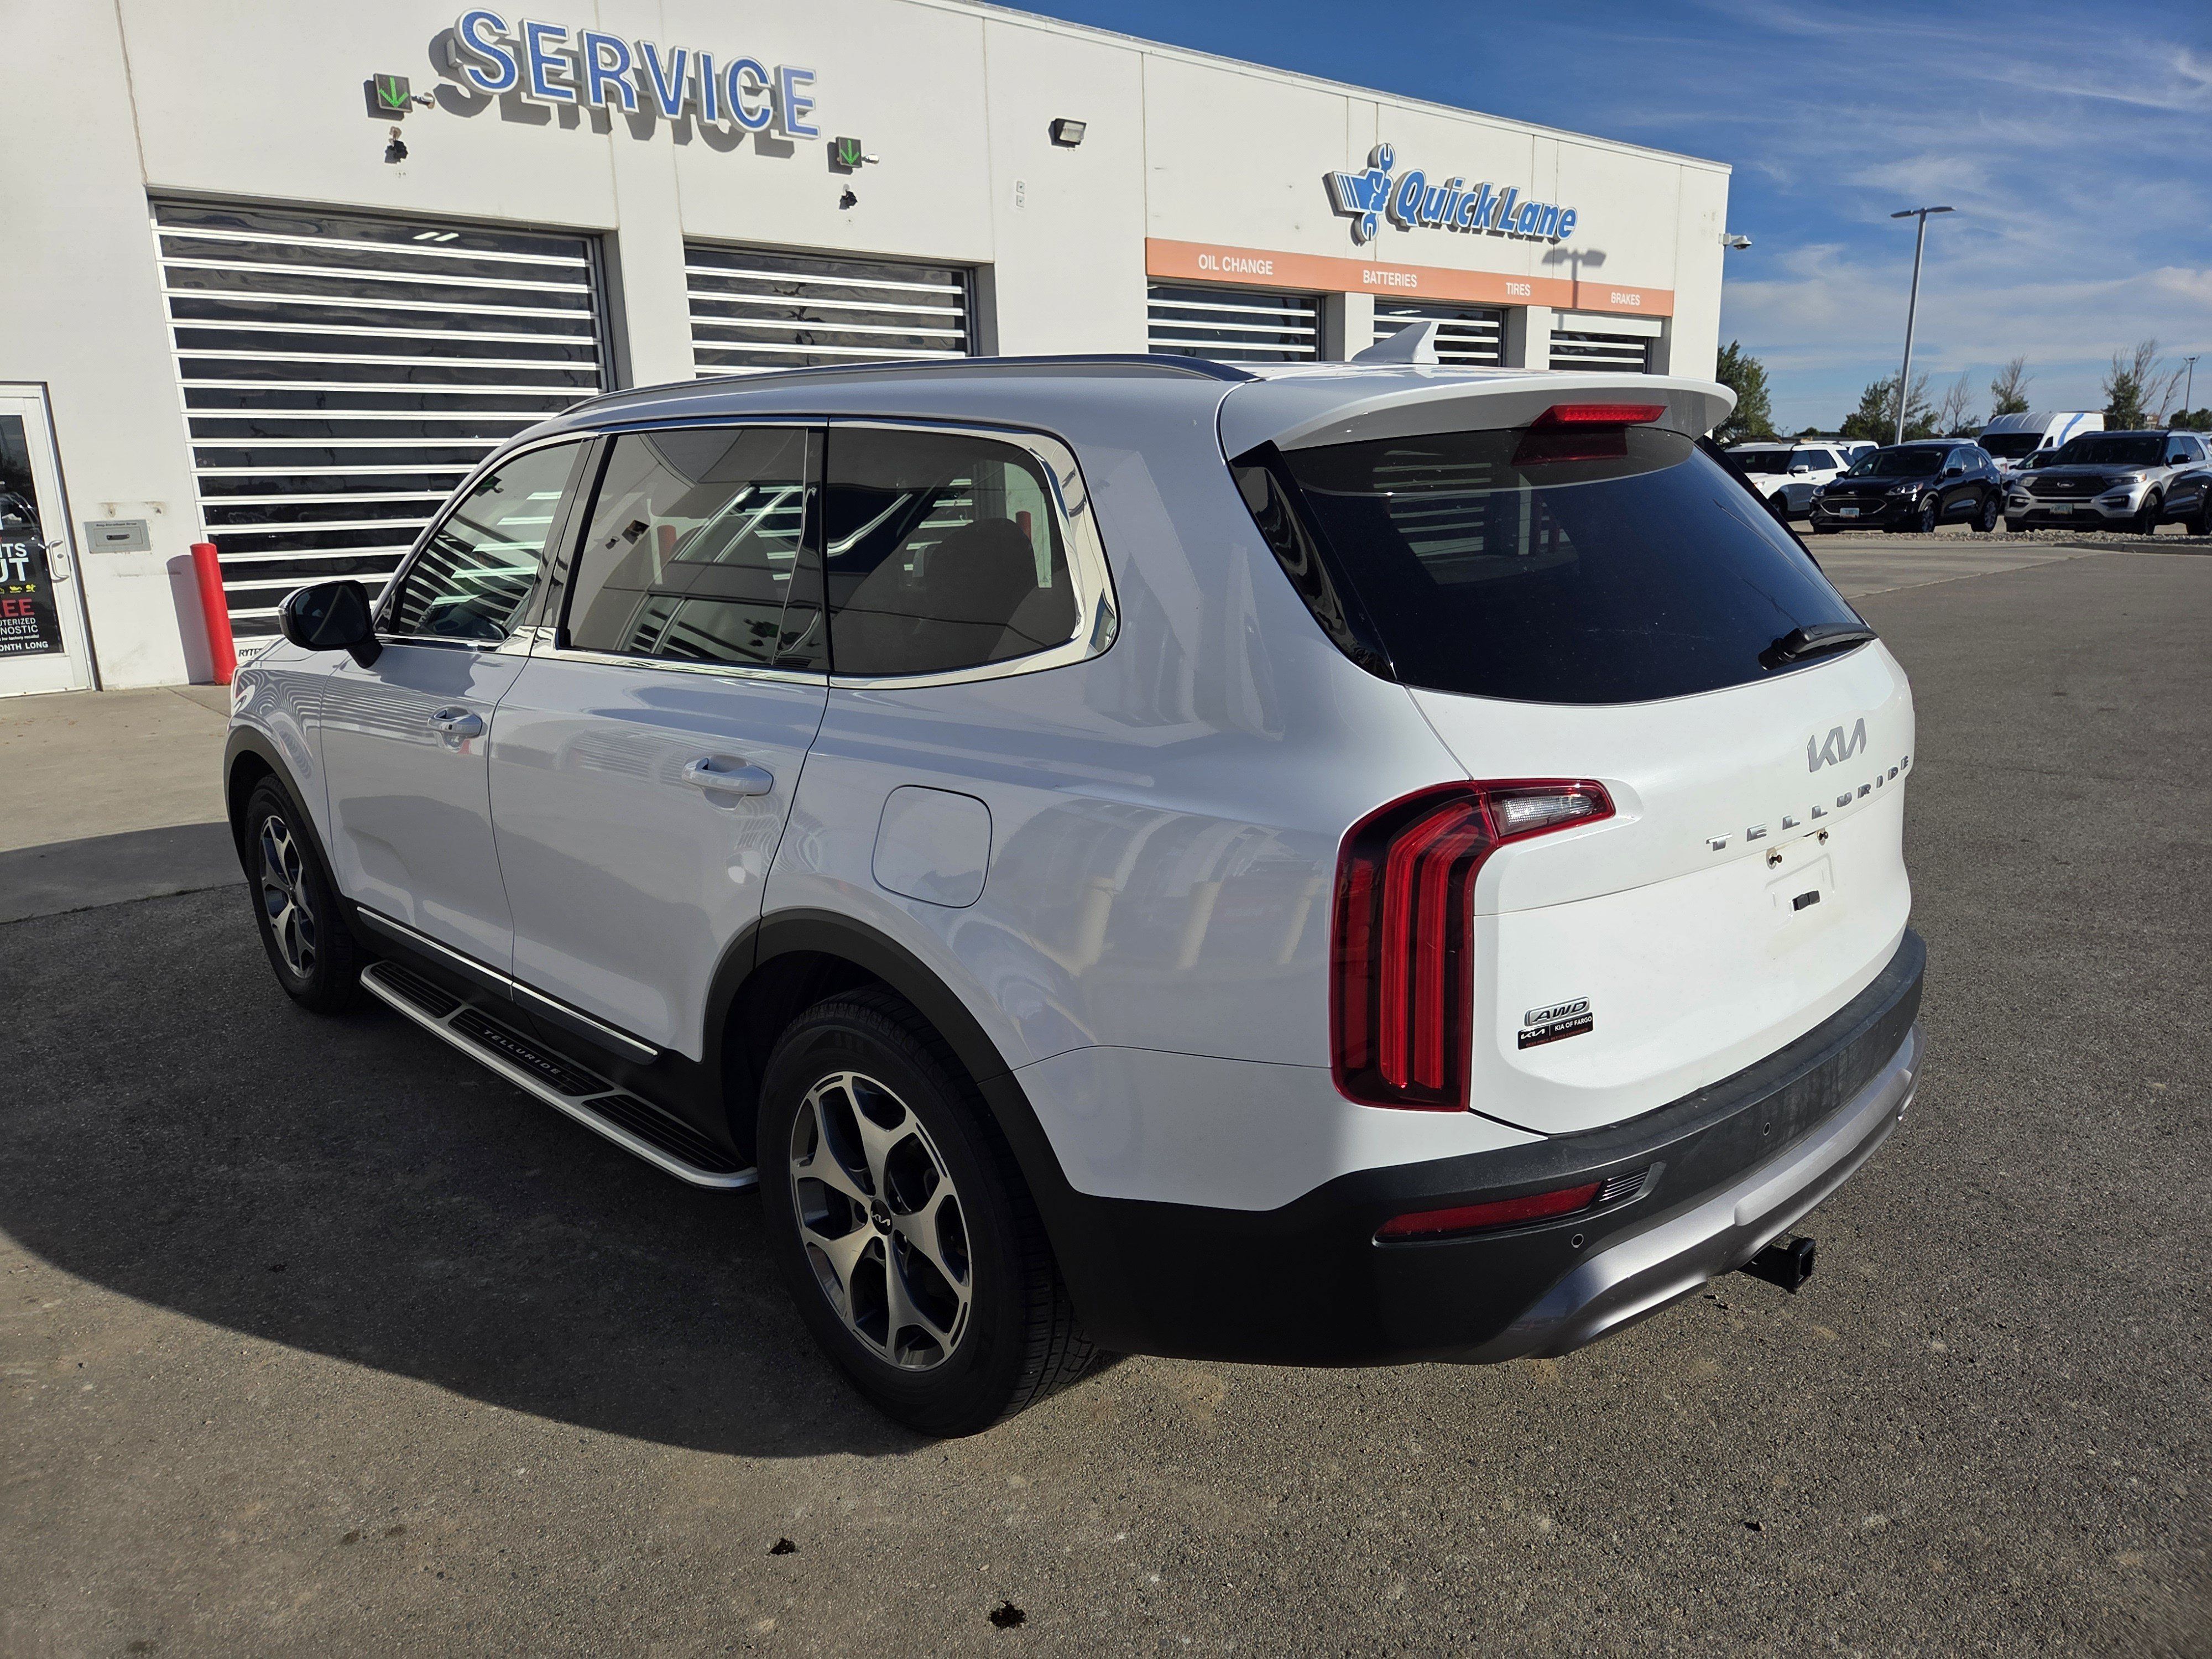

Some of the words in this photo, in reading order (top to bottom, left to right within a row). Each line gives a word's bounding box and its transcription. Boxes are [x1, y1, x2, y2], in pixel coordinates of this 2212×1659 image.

[451, 8, 820, 139] SERVICE
[1395, 169, 1501, 229] Quick
[1496, 186, 1578, 241] Lane
[1198, 254, 1219, 271] OIL
[1222, 257, 1273, 275] CHANGE
[1363, 270, 1417, 288] BATTERIES
[1505, 282, 1531, 296] TIRES
[1610, 292, 1640, 306] BRAKES
[0, 542, 27, 559] TS
[0, 598, 35, 618] EE
[25, 640, 49, 650] LONG
[1705, 755, 1909, 852] TELLURIDE
[1532, 1000, 1588, 1022] AWD
[1554, 1024, 1564, 1032] KIA
[1574, 1015, 1593, 1026] FARGO
[484, 1029, 561, 1074] TELLURIDE
